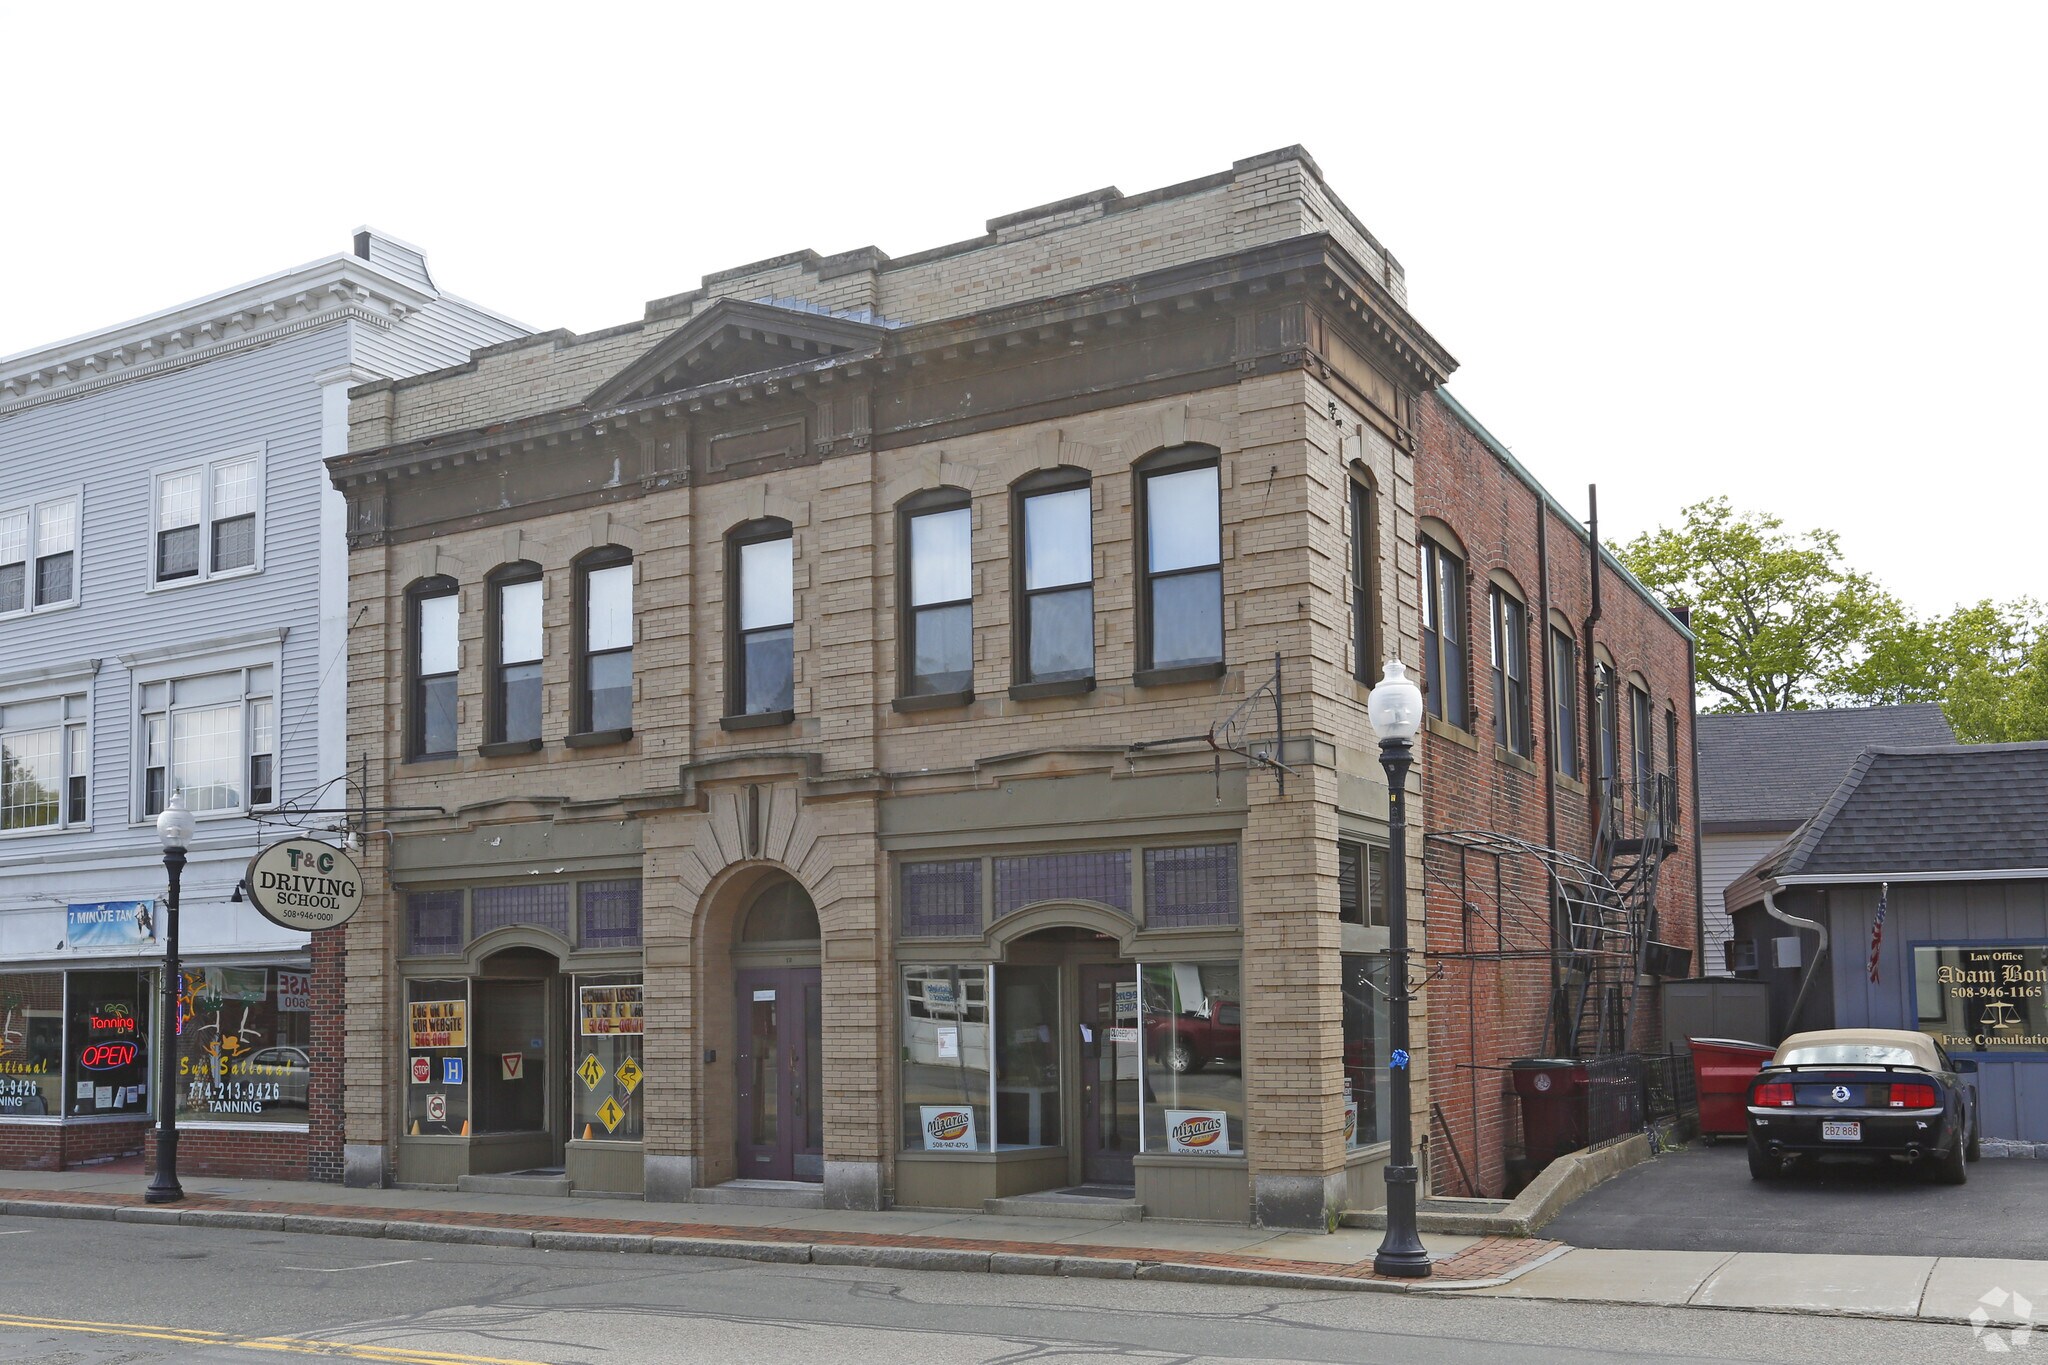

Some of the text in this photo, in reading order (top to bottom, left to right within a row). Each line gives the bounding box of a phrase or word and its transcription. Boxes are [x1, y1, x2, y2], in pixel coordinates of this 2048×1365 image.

[287, 848, 334, 875] T&C
[260, 871, 356, 898] DRIVING
[277, 892, 340, 910] SCHOOL
[69, 909, 133, 925] 7 MINUTE TAN
[1970, 952, 2024, 961] Law Office
[1937, 965, 1996, 984] Adam
[1951, 986, 2042, 998] 508-946-1165
[412, 1003, 454, 1018] LOG ON TO
[90, 1016, 135, 1030] Tanning
[413, 1018, 428, 1032] OUR
[1942, 1034, 1972, 1045] Free
[82, 1046, 134, 1065] OPEN
[414, 1065, 429, 1075] STOP
[448, 1061, 459, 1080] H
[208, 1100, 262, 1113] TANNING
[927, 1113, 969, 1136] Mizaras
[1172, 1118, 1221, 1143] Mizaras
